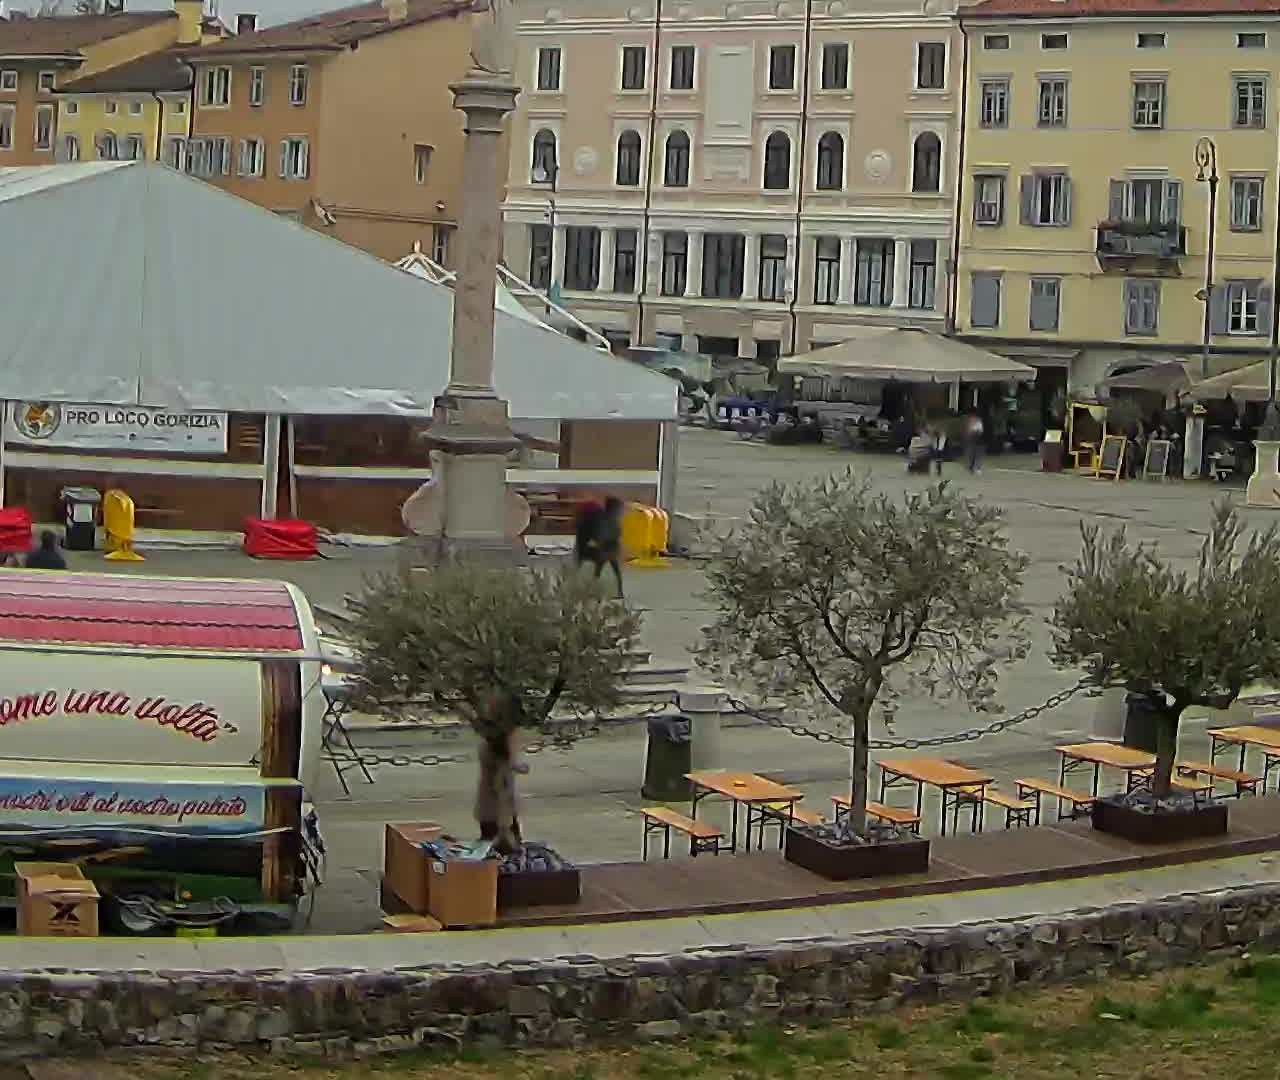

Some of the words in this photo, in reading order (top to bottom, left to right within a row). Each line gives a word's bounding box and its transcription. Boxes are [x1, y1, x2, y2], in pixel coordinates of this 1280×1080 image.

[66, 410, 100, 425] PRO
[104, 411, 150, 428] LOCO
[153, 413, 221, 429] GORIZIA
[64, 687, 130, 716] una
